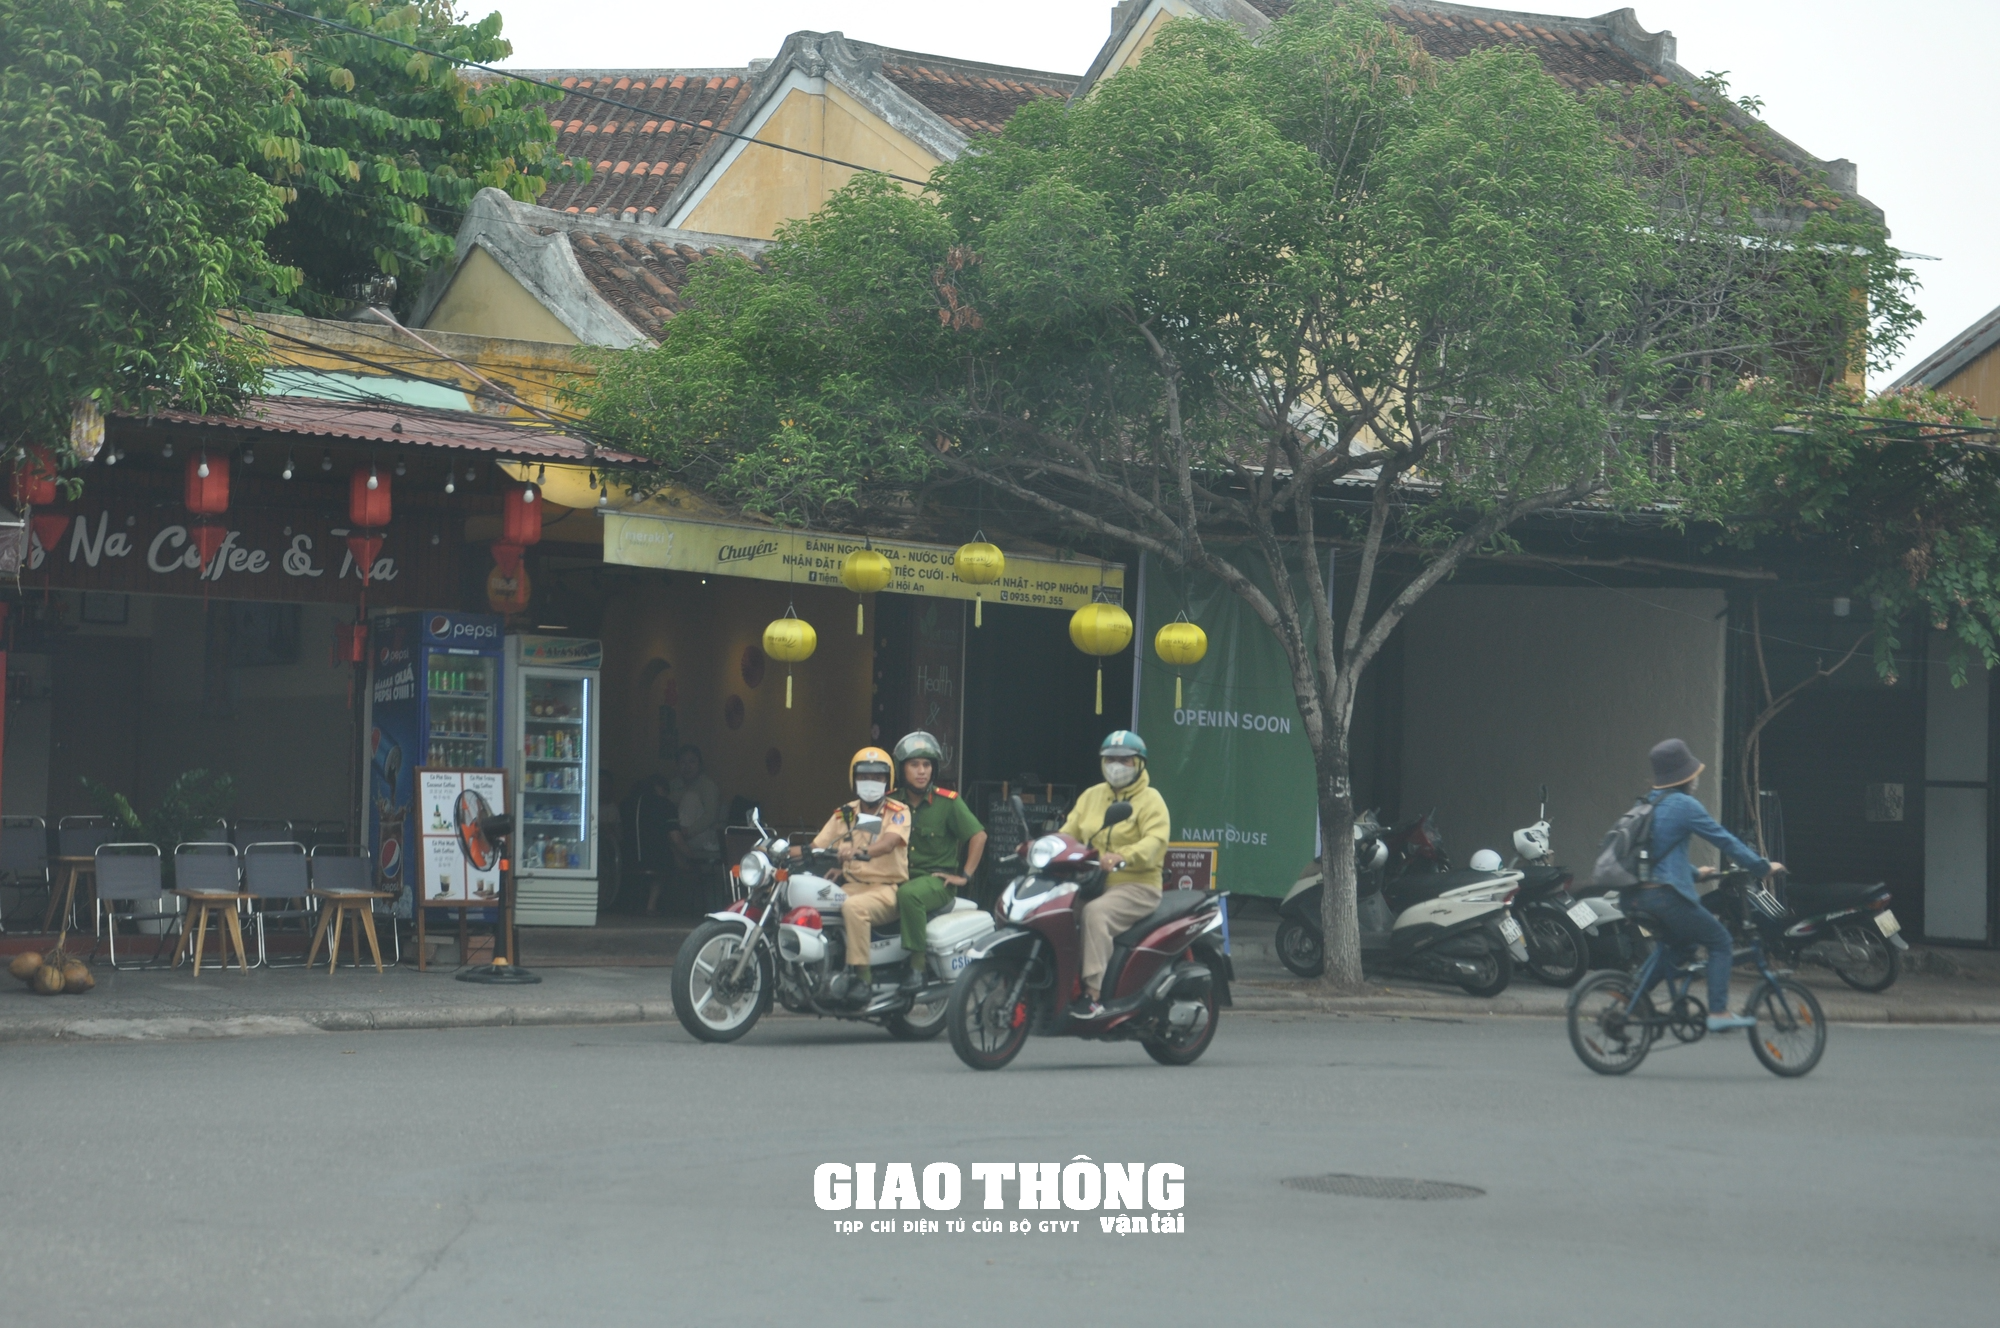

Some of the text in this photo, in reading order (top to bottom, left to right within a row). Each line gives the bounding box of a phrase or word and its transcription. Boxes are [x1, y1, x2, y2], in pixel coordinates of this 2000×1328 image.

[68, 509, 133, 568] Na
[282, 534, 324, 578] &
[718, 539, 779, 561] Chuyên:
[806, 539, 834, 552] BÁNH
[909, 551, 938, 565] NƯỚC
[782, 554, 812, 568] NHẬN
[815, 556, 835, 572] ĐẶT
[894, 565, 915, 580] TIỆC
[918, 567, 944, 581] CƯỚI
[1003, 576, 1028, 591] NHẬT
[1059, 581, 1088, 595] NHÓM
[818, 572, 838, 584] Tiệm
[913, 582, 925, 592] An
[1009, 591, 1063, 605] 0935.991.355
[453, 623, 497, 639] pepsi
[390, 648, 409, 660] pepsi
[547, 646, 589, 658] ALASKA
[917, 664, 953, 697] Health
[1241, 713, 1291, 734] SOON
